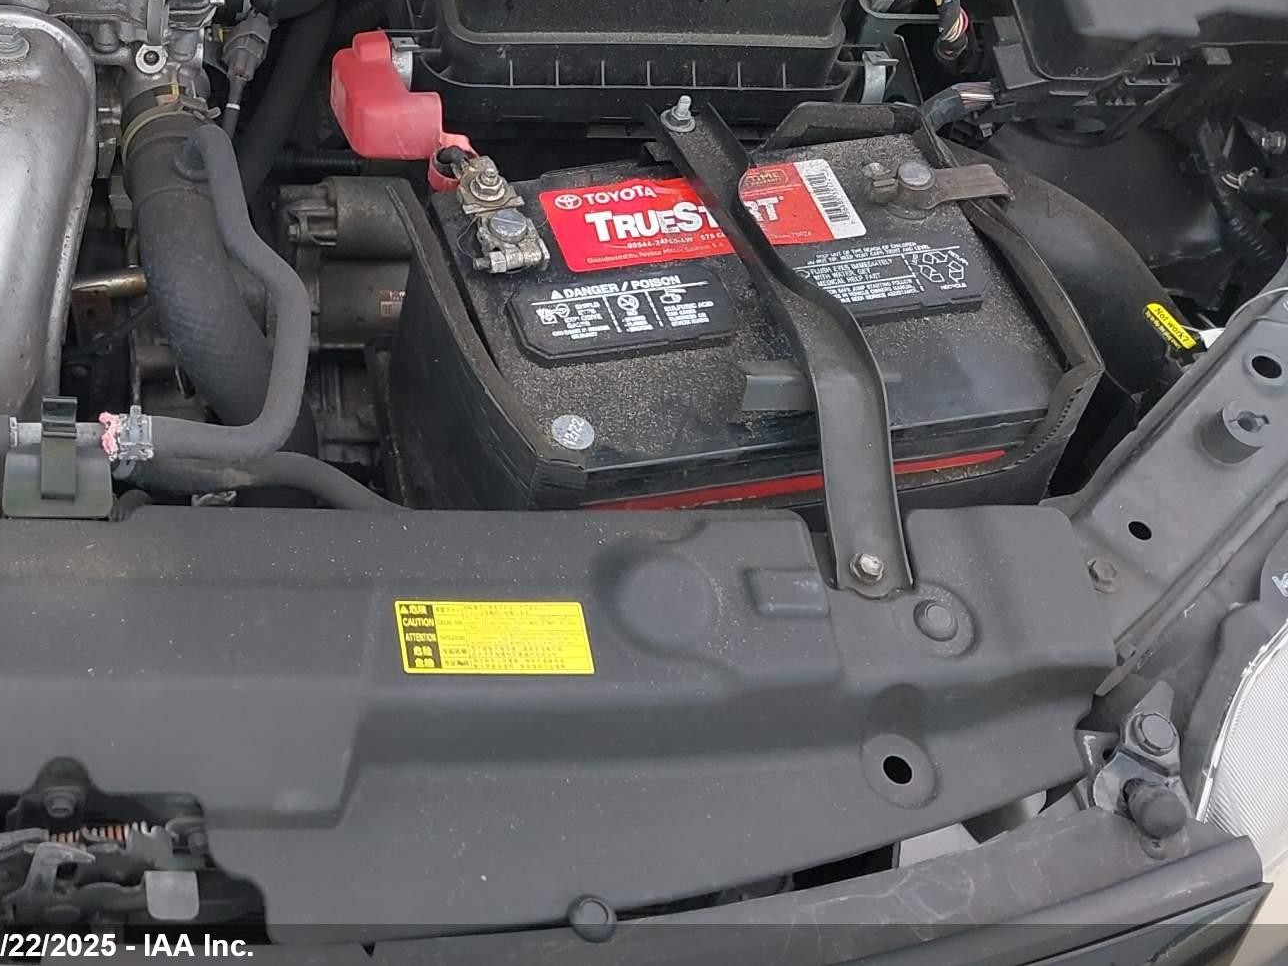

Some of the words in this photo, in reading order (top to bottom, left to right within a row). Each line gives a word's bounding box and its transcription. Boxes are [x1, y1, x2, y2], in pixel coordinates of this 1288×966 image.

[582, 184, 658, 206] TOYOTA
[810, 267, 833, 276] FLUSH
[833, 265, 851, 273] EYES
[813, 273, 832, 282] WITH
[817, 278, 847, 287] MEDICAL
[846, 275, 864, 284] HELP
[865, 272, 881, 281] FAST
[563, 283, 620, 299] DANGER
[630, 275, 681, 290] POISON
[1167, 321, 1190, 343] work?
[402, 617, 435, 627] CAUTION
[405, 632, 437, 642] ATTENTION
